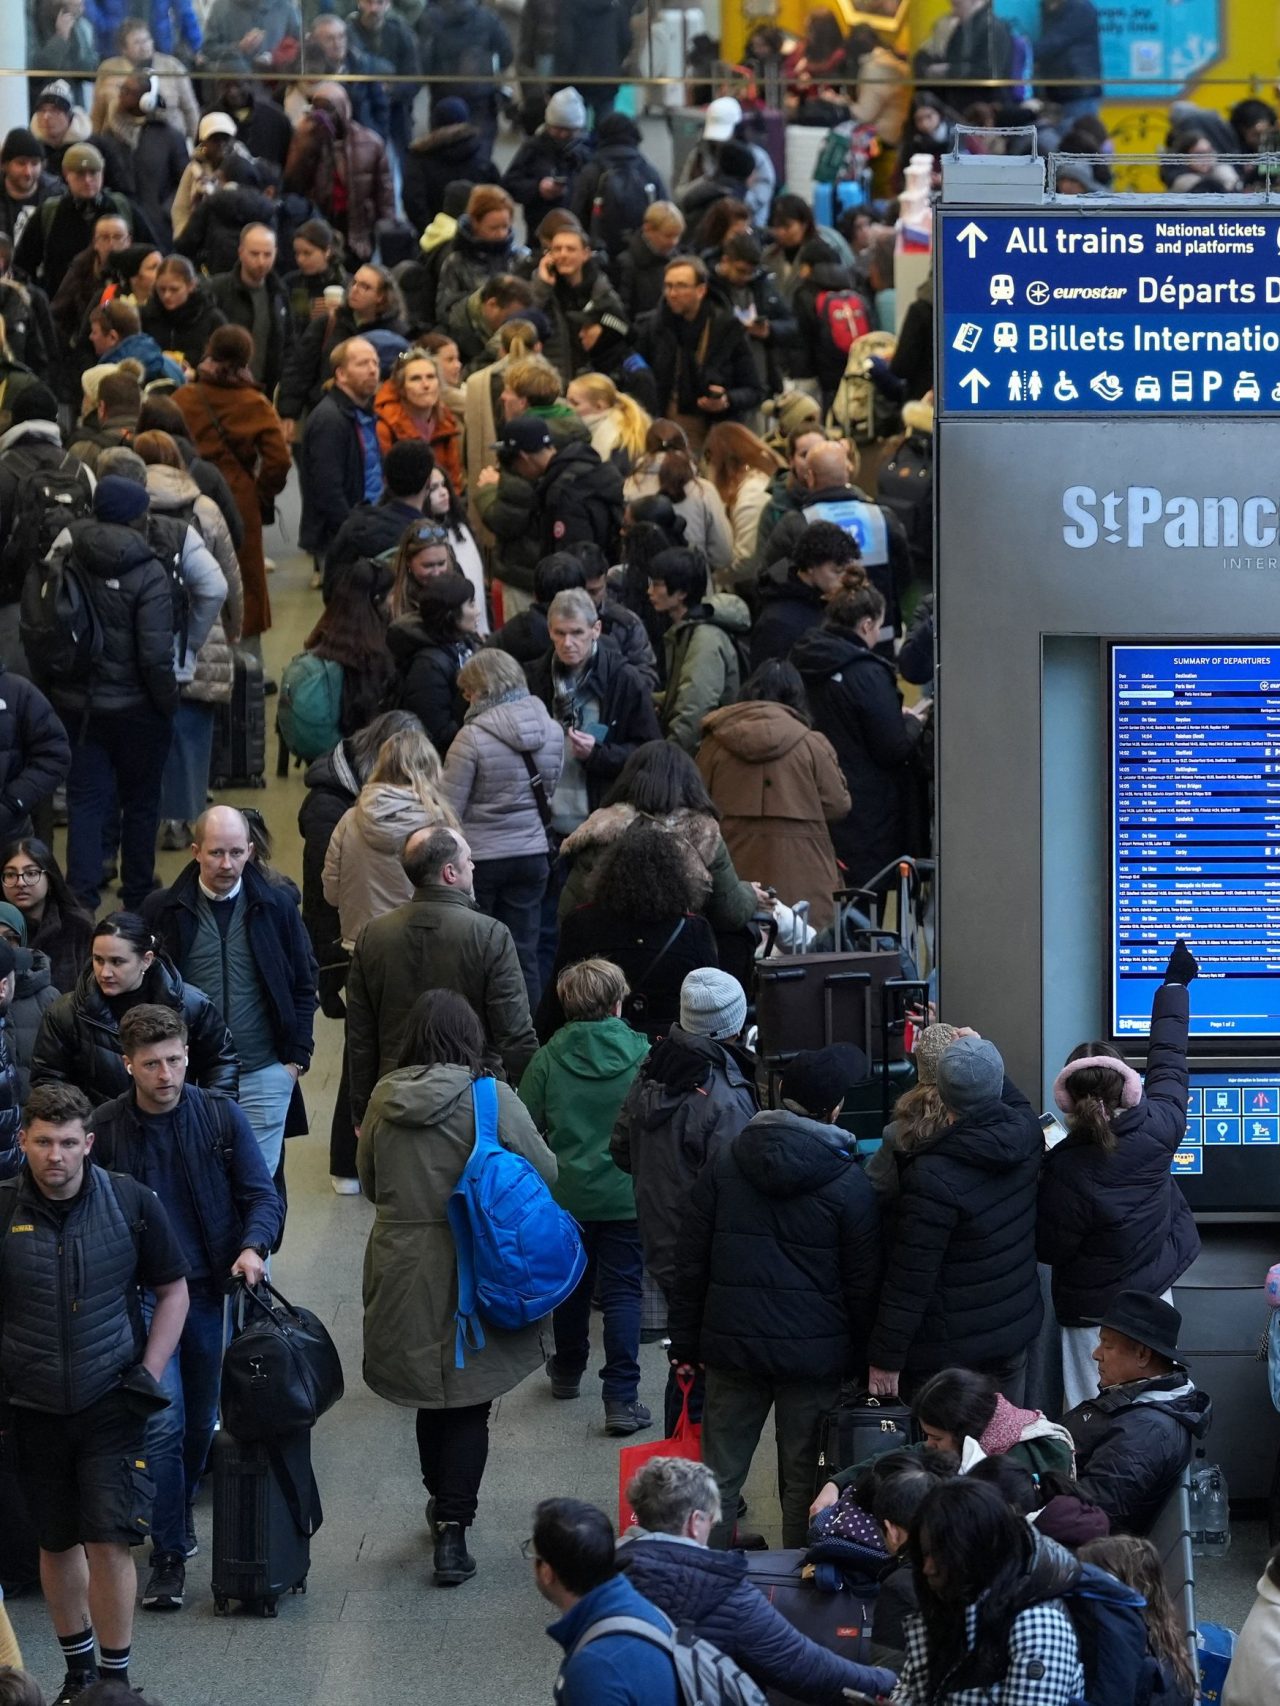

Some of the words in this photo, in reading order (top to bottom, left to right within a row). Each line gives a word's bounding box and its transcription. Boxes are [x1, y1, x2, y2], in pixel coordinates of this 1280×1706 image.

[1006, 227, 1048, 253] All
[1056, 227, 1144, 253] trains
[1156, 224, 1214, 236] National
[1218, 224, 1265, 236] tickets
[1156, 240, 1181, 253] and
[1186, 240, 1254, 256] platforms
[1053, 286, 1127, 299] eurostar
[1139, 276, 1255, 309] Départs
[1029, 325, 1124, 350] Billets
